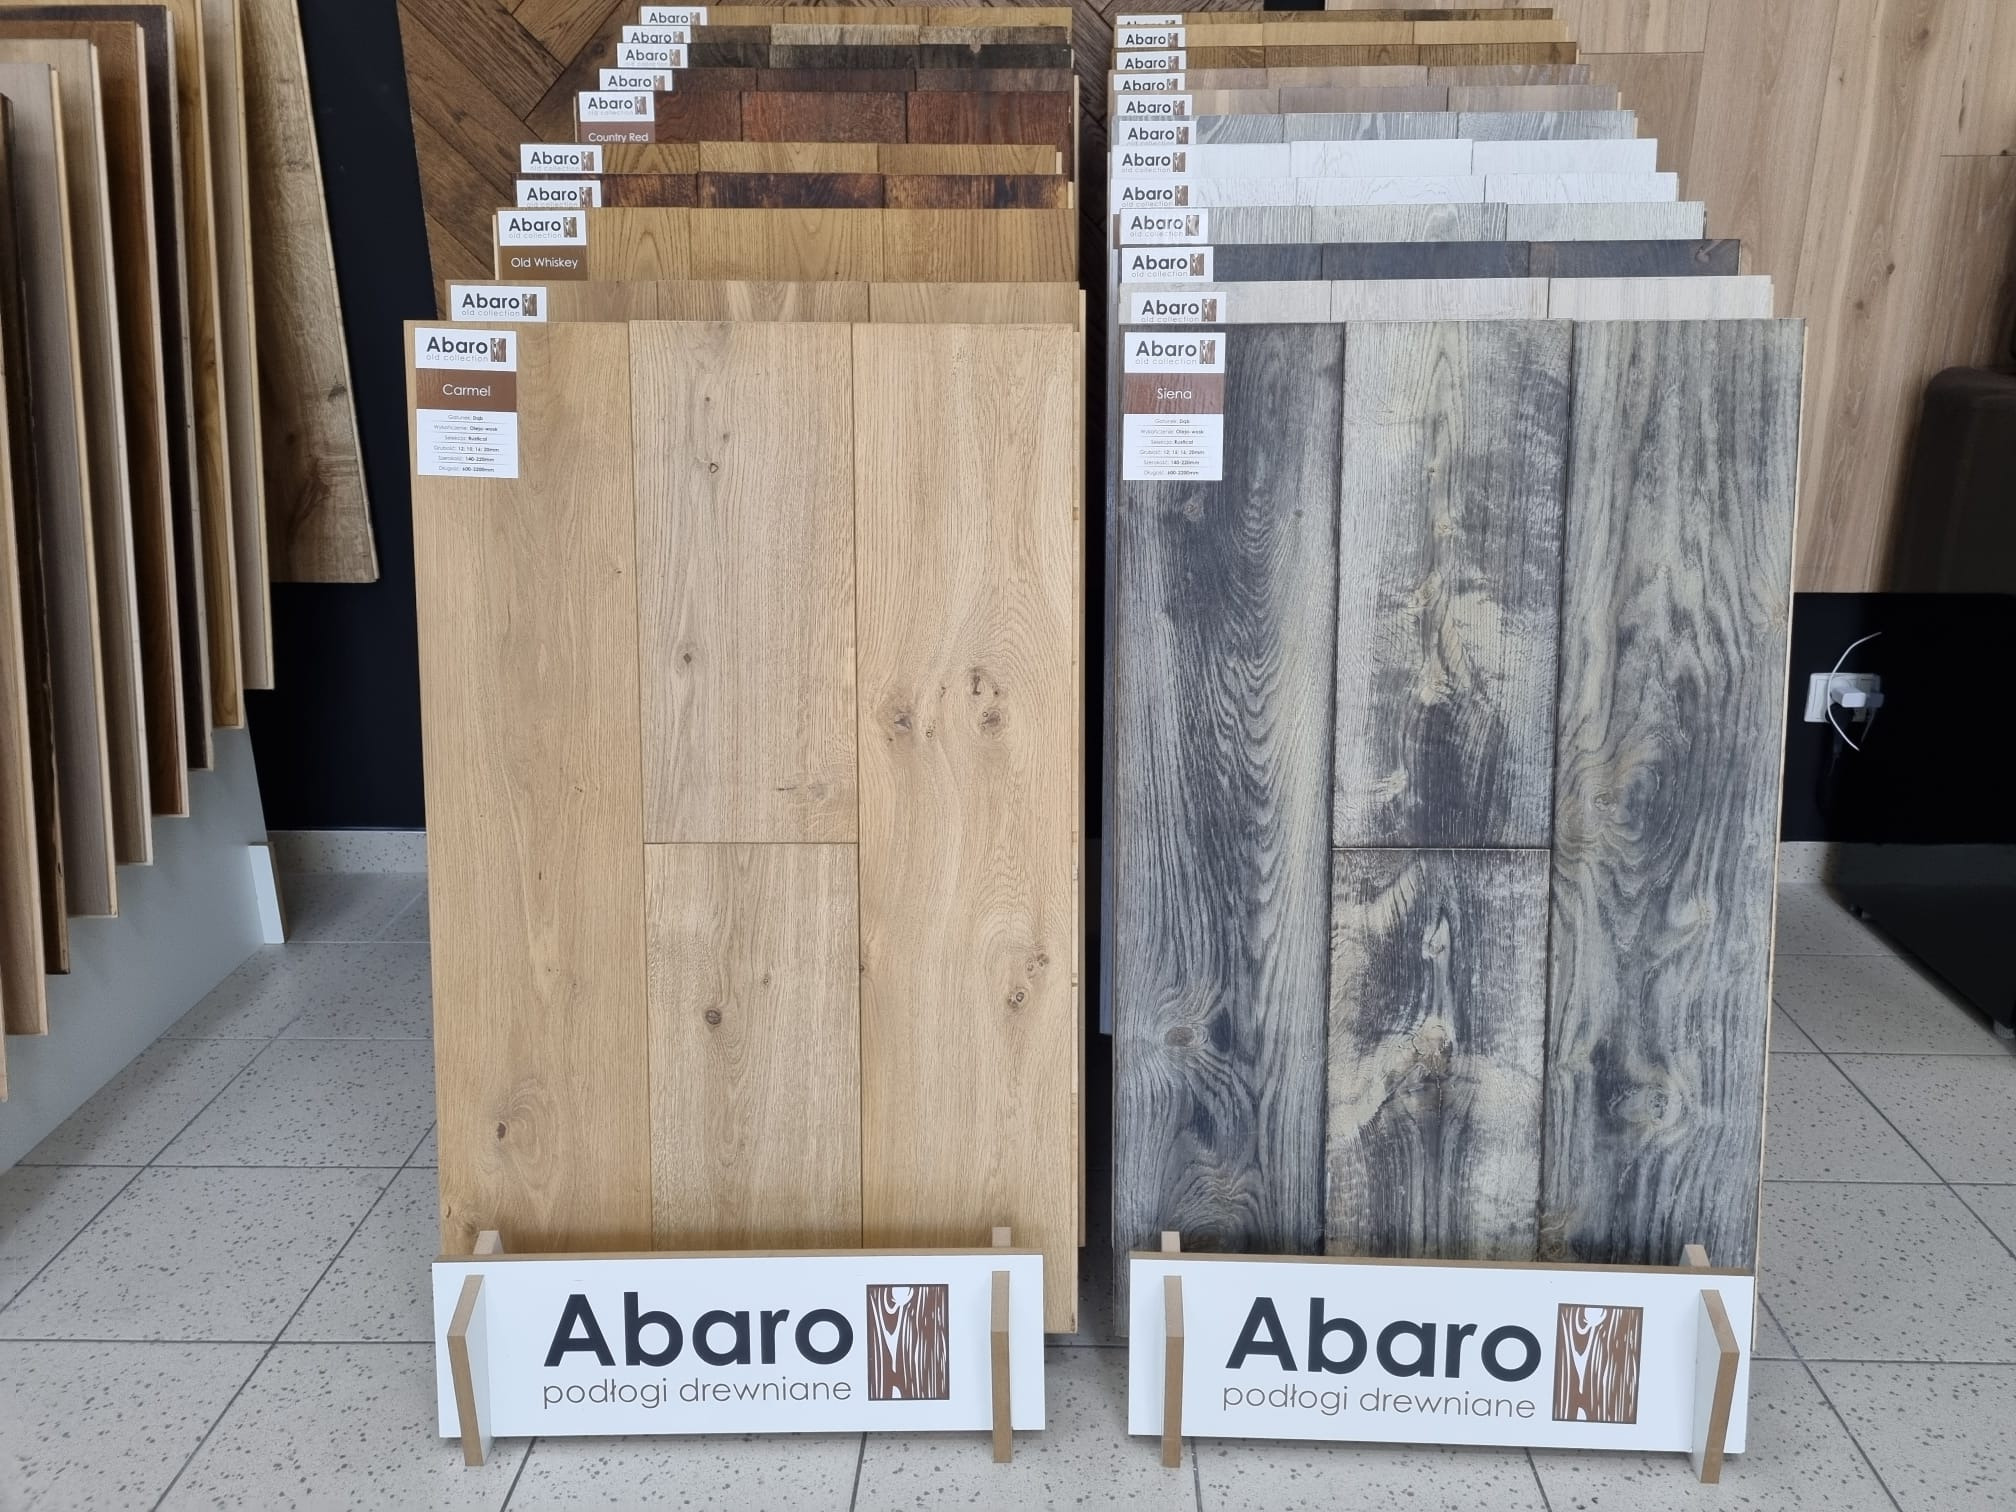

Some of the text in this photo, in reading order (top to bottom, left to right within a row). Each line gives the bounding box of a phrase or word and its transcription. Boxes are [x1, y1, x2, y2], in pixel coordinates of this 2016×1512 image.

[649, 12, 688, 24] Abaro
[631, 32, 672, 43] Abaro
[1126, 34, 1166, 45] Abaro
[626, 50, 668, 61] Abaro
[1124, 58, 1166, 69] Abaro
[608, 75, 652, 88] Abaro
[1122, 80, 1165, 90] Abaro
[588, 98, 633, 110] Abaro
[1126, 102, 1171, 114] Abaro
[588, 133, 648, 143] Country Red
[1128, 128, 1174, 140] Abaro
[530, 152, 579, 165] Abaro
[1122, 154, 1170, 166] Abaro
[526, 187, 577, 201] Abaro
[1122, 187, 1173, 200] Abaro
[508, 218, 561, 232] Abaro
[1130, 216, 1184, 230] Abaro
[511, 258, 578, 269] Old Whiskey
[1132, 255, 1187, 270] Abaro
[462, 294, 519, 309] Abaro
[1142, 300, 1199, 315] Abaro
[426, 336, 488, 354] Abaro
[1136, 340, 1197, 357] Abaro
[442, 384, 491, 396] Carmel
[1157, 388, 1192, 400] Siena
[543, 1291, 854, 1368] Abaro
[1225, 1296, 1542, 1382] Abaro
[542, 1376, 852, 1410] podłogi drewniane
[1222, 1384, 1536, 1419] podłogi drewniane
